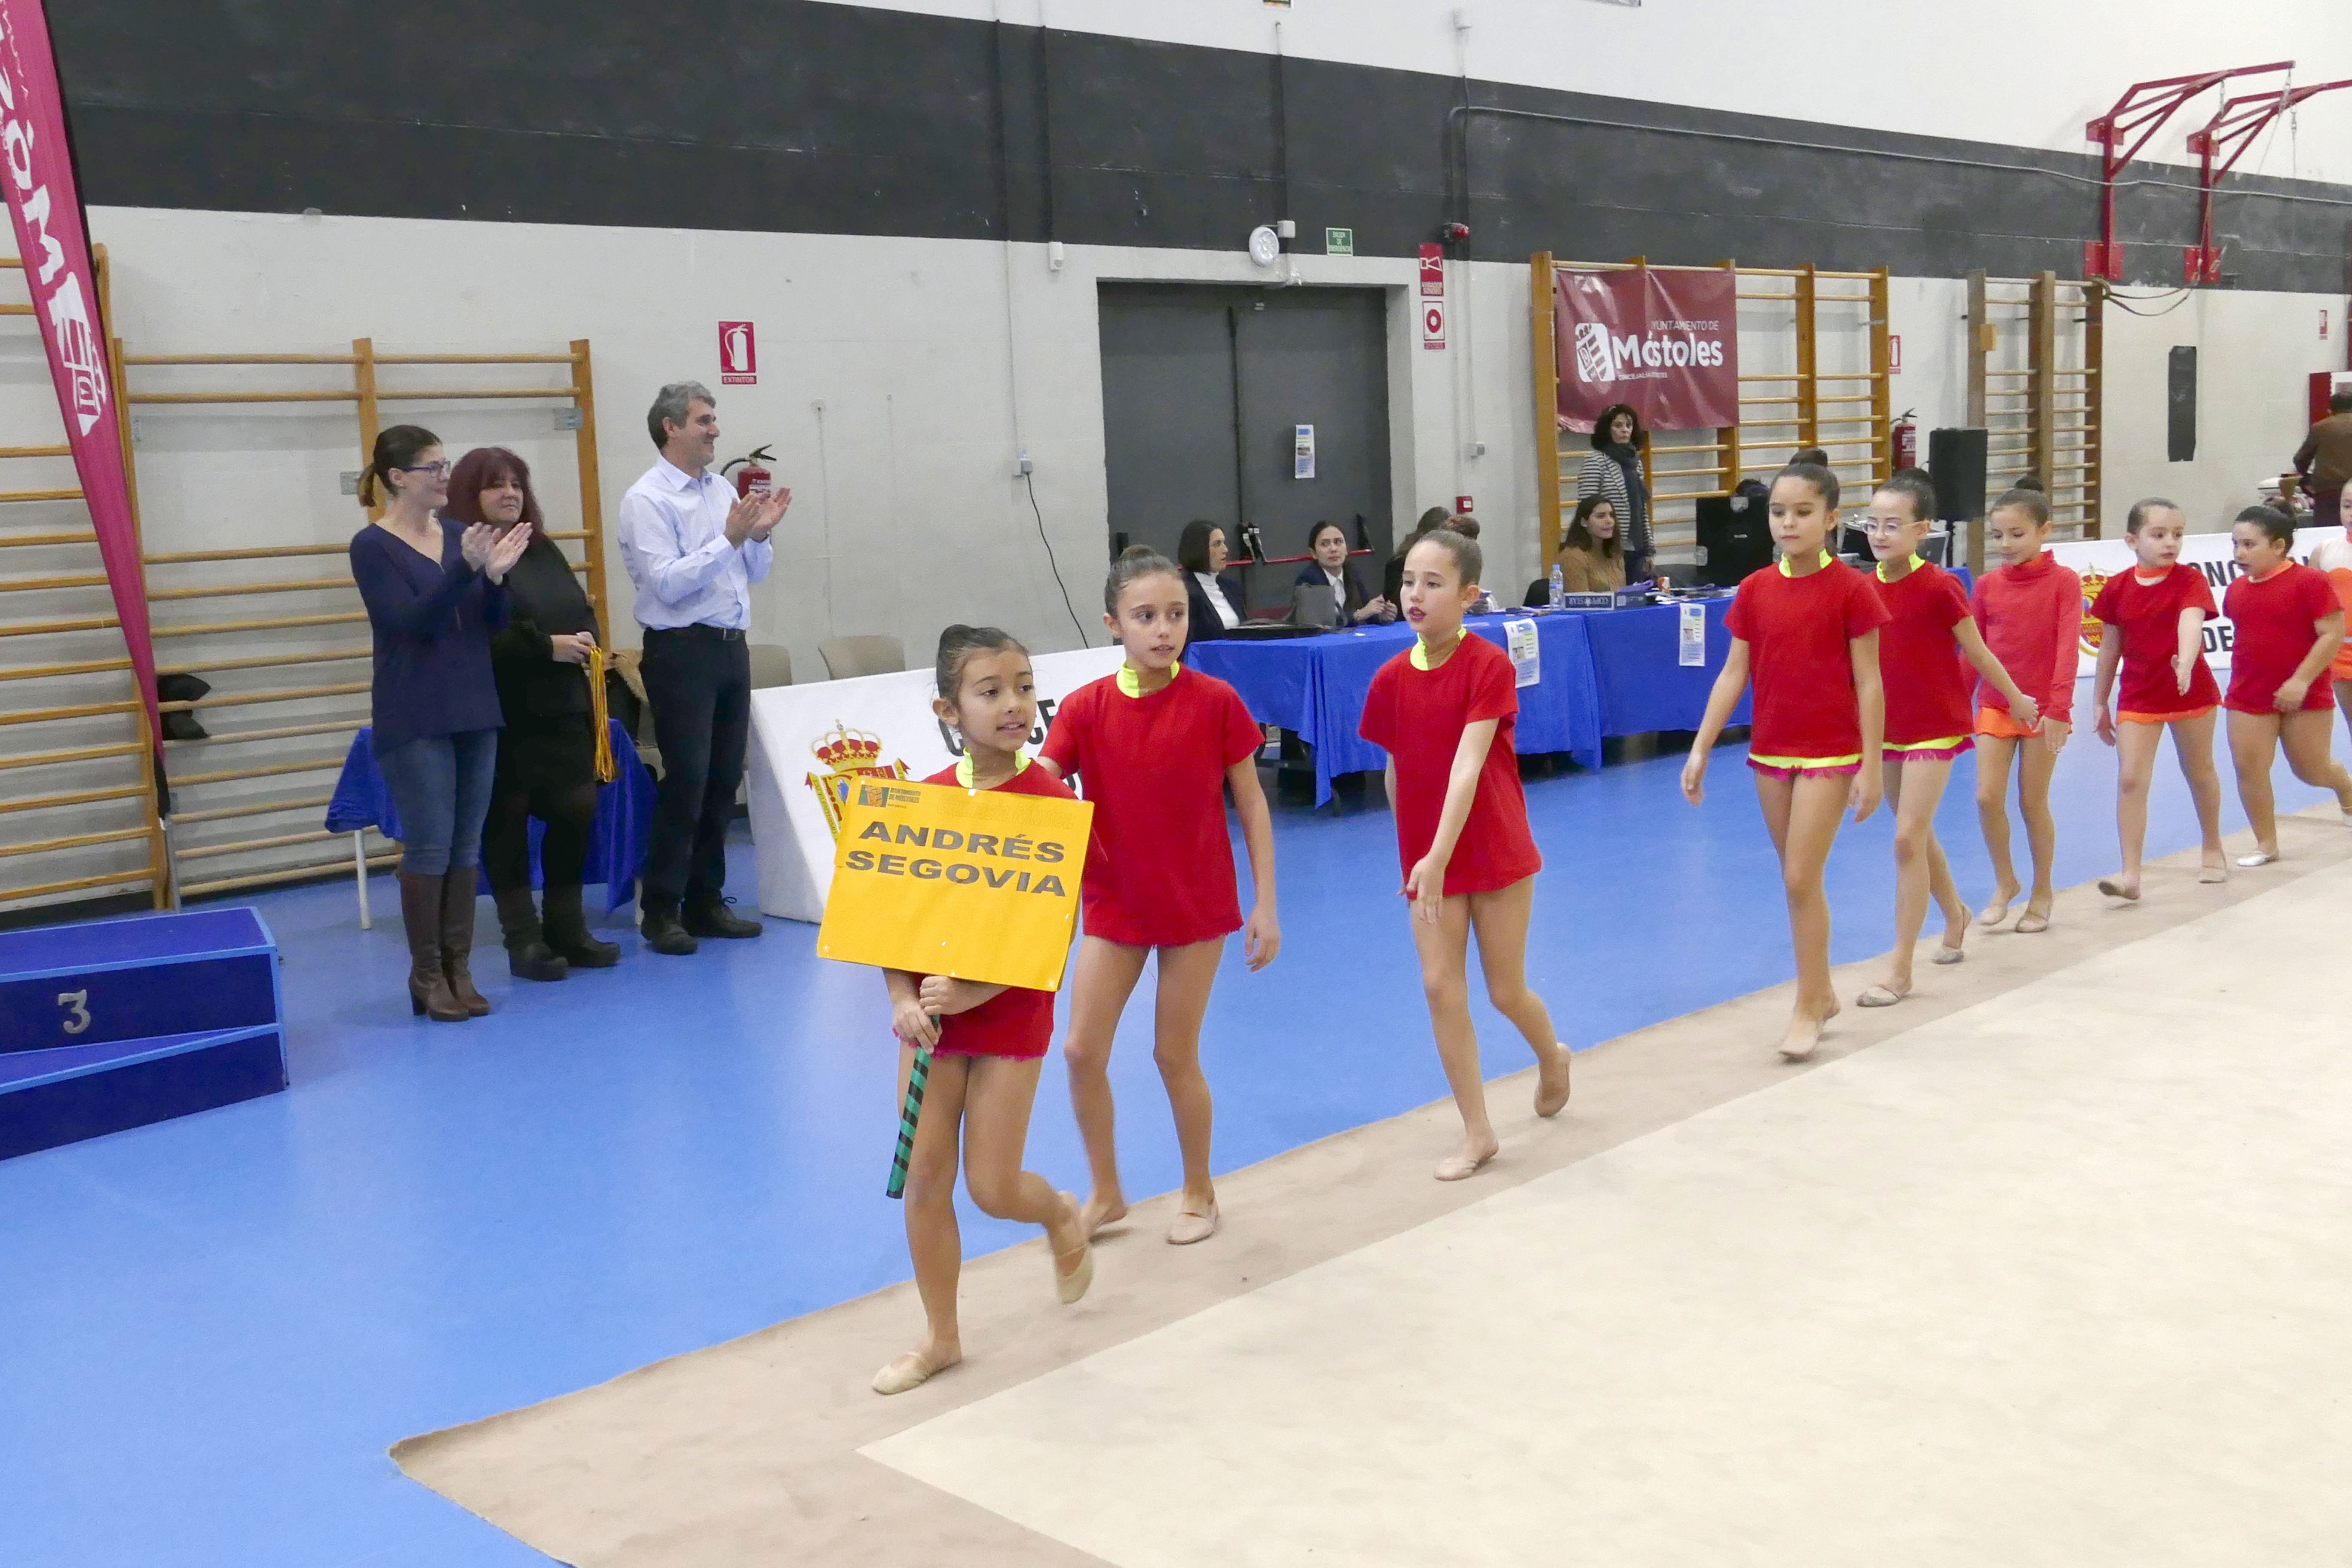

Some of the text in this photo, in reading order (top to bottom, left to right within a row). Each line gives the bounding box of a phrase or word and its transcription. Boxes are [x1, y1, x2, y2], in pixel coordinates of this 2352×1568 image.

[1709, 321, 1719, 330] DE
[1612, 330, 1723, 369] Móstoles
[858, 821, 1066, 863] ANDRÉS
[845, 850, 1066, 897] SEGOVIA
[58, 989, 91, 1034] 3
